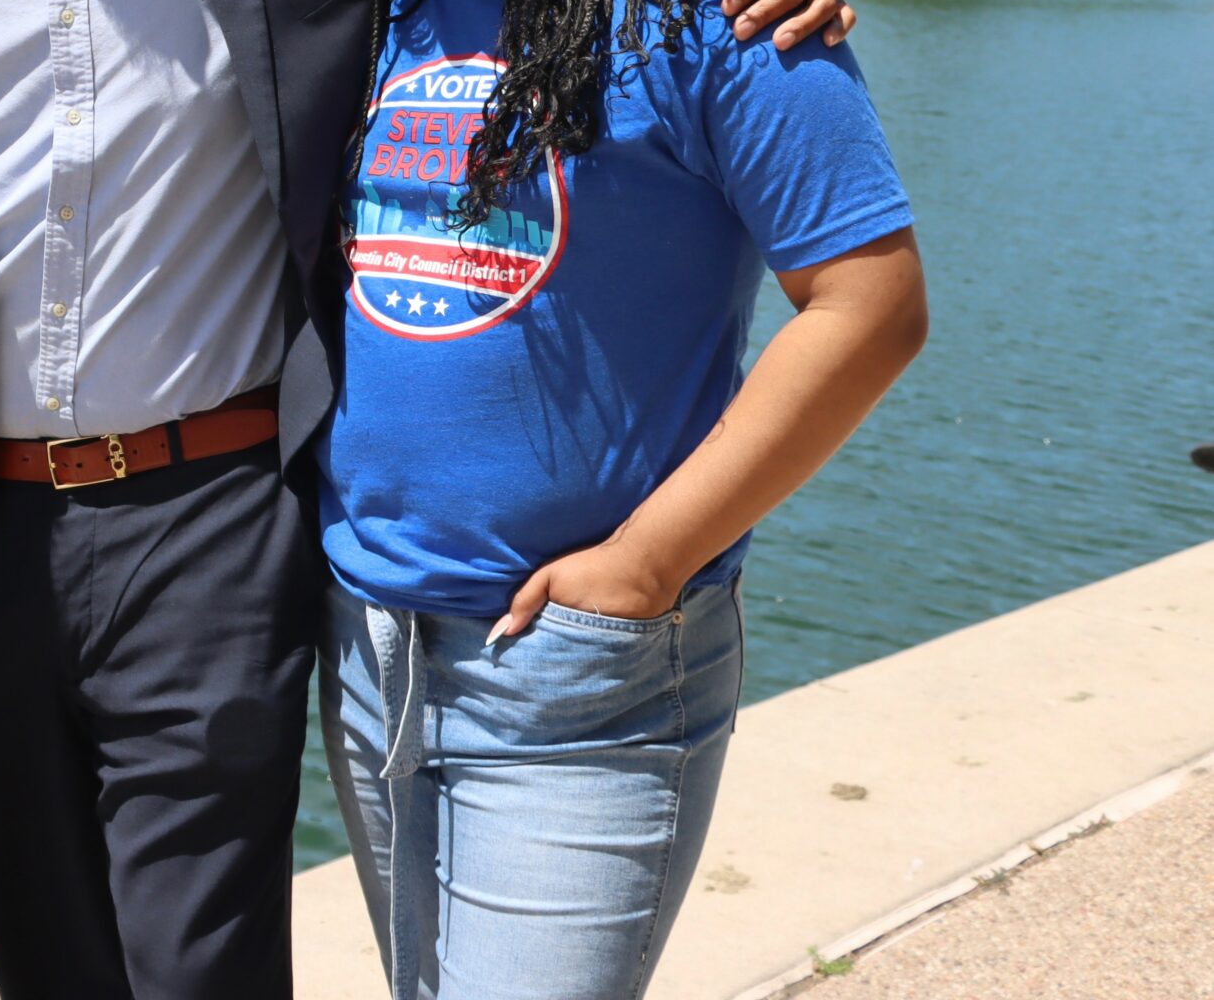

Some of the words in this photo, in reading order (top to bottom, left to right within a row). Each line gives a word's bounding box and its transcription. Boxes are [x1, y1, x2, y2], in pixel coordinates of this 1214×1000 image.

[425, 74, 497, 99] VOTE
[387, 109, 486, 145] STEVE
[367, 143, 482, 185] BROW
[384, 251, 406, 272] City
[408, 254, 458, 276] Council
[460, 260, 514, 283] District
[519, 268, 526, 283] 1
